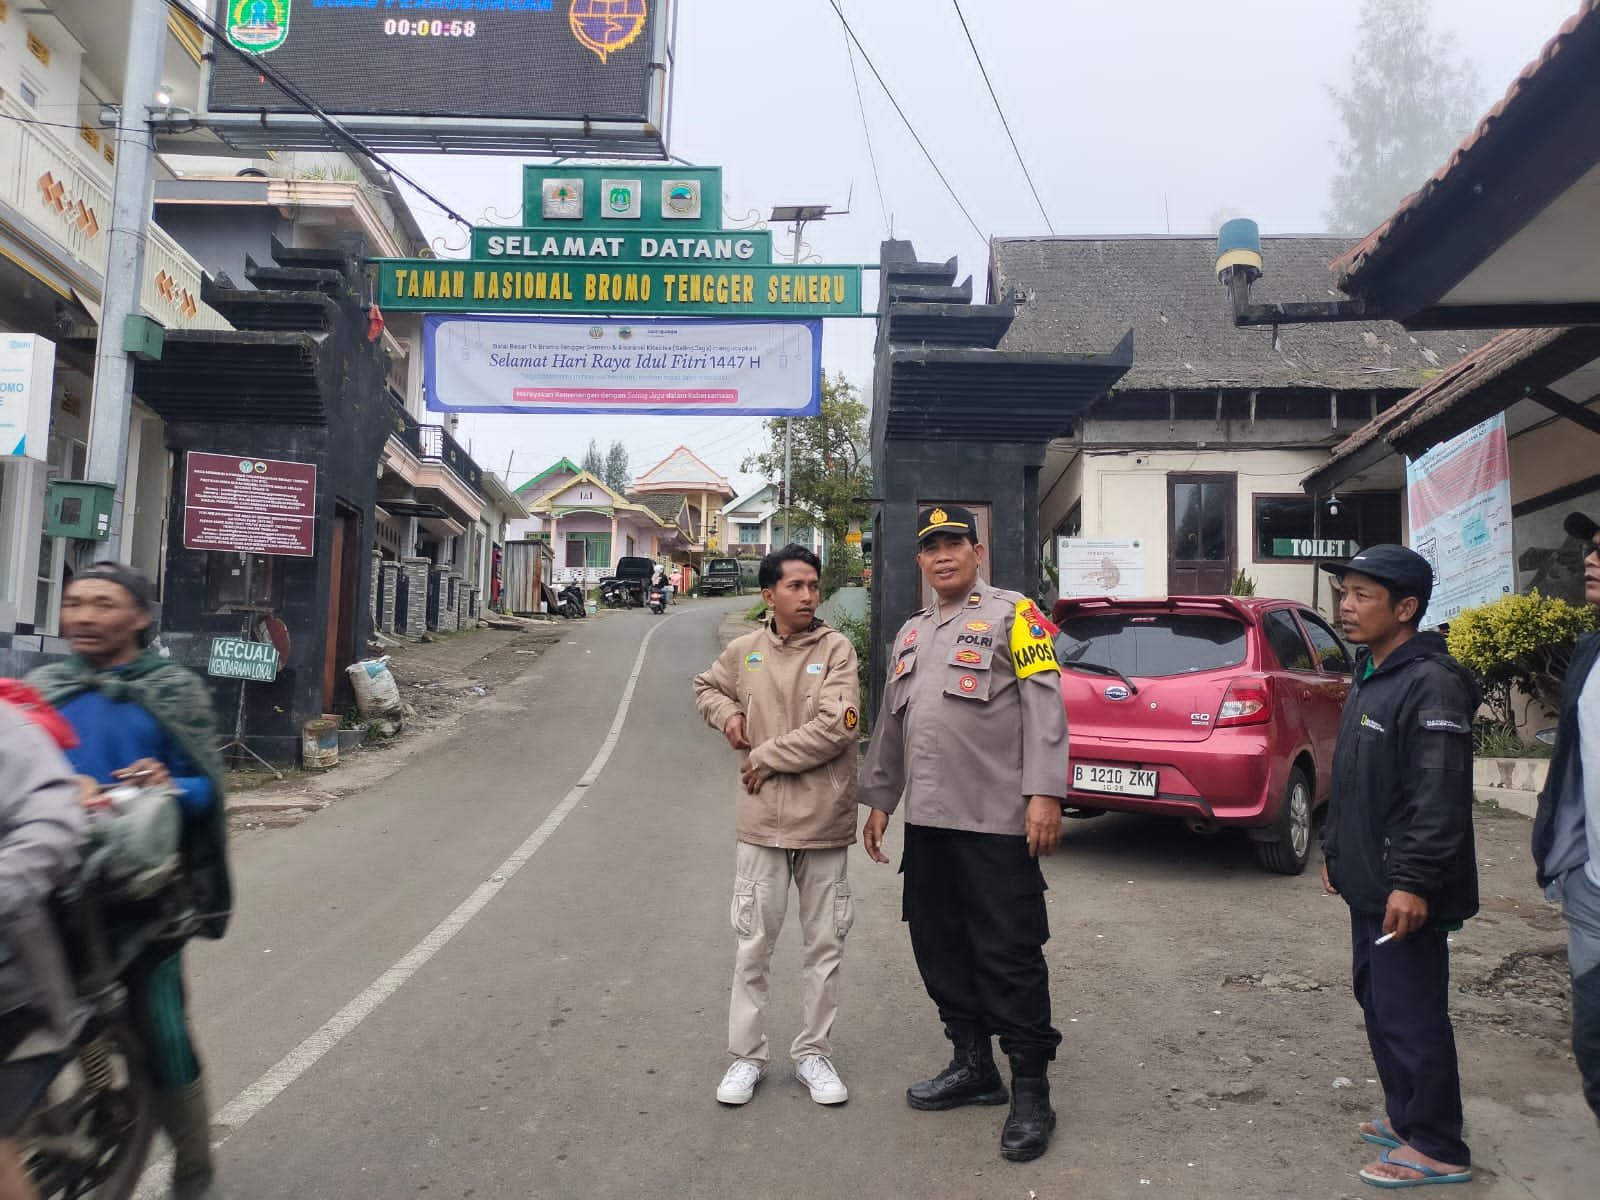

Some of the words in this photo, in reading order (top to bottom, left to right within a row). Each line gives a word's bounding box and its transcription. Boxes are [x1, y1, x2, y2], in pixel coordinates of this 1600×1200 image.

[385, 18, 476, 37] 00:00:58
[487, 236, 625, 258] SELAMAT
[640, 238, 755, 260] DATANG
[395, 269, 465, 299] TAMAN
[473, 271, 573, 300] NASIONAL
[585, 273, 651, 302] BROMO
[663, 274, 754, 304] TENGGER
[767, 275, 846, 304] SEMERU
[488, 352, 548, 368] Selamat
[551, 353, 588, 369] Hari
[591, 353, 631, 372] Raya
[635, 353, 667, 369] Idul
[671, 353, 708, 369] Fitri
[710, 355, 746, 369] 1447
[750, 355, 761, 369] H
[1290, 538, 1345, 557] TOILET
[956, 634, 993, 648] POLRI
[213, 640, 277, 663] KECUALI
[210, 657, 252, 677] KENDARAAN
[251, 662, 273, 680] LOKAL
[1190, 713, 1210, 721] GO
[1075, 766, 1084, 781] B
[1129, 770, 1155, 787] ZKK
